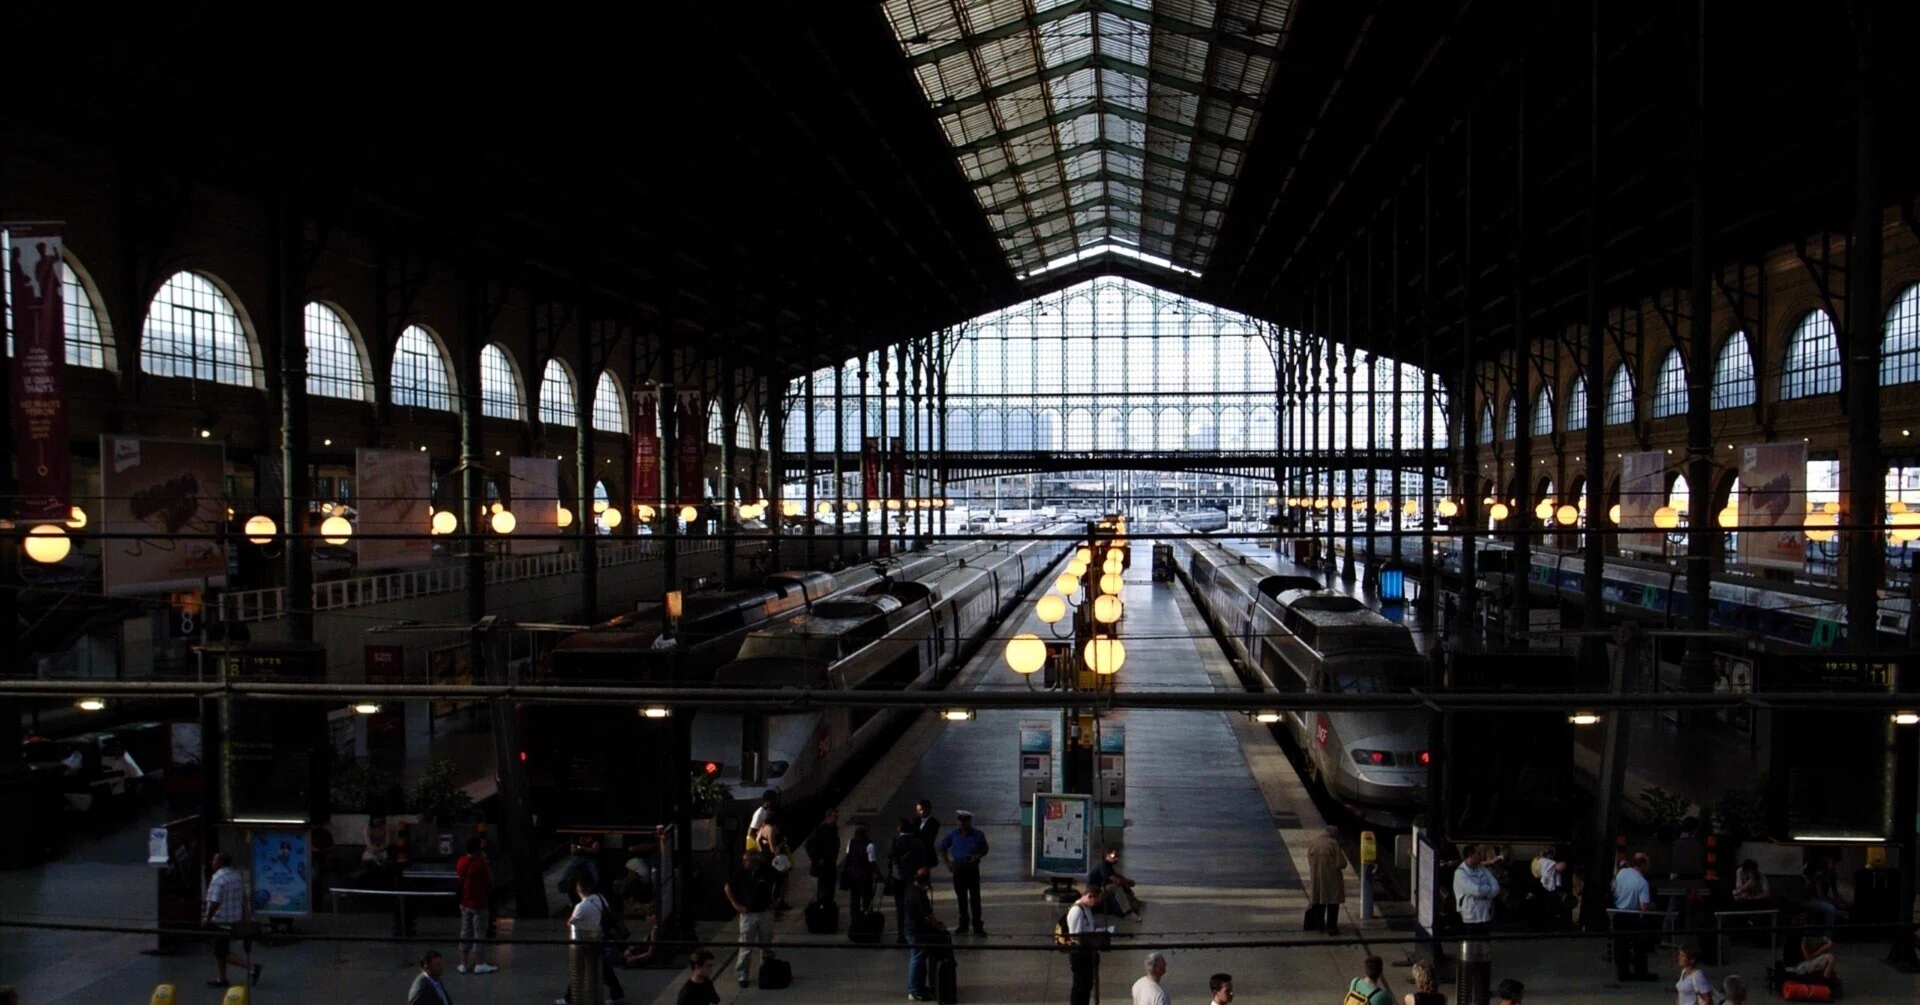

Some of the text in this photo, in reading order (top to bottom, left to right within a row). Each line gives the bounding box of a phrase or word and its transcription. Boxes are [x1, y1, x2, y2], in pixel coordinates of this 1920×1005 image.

[181, 609, 195, 634] 8
[230, 664, 240, 677] 8
[1870, 669, 1887, 684] 11
